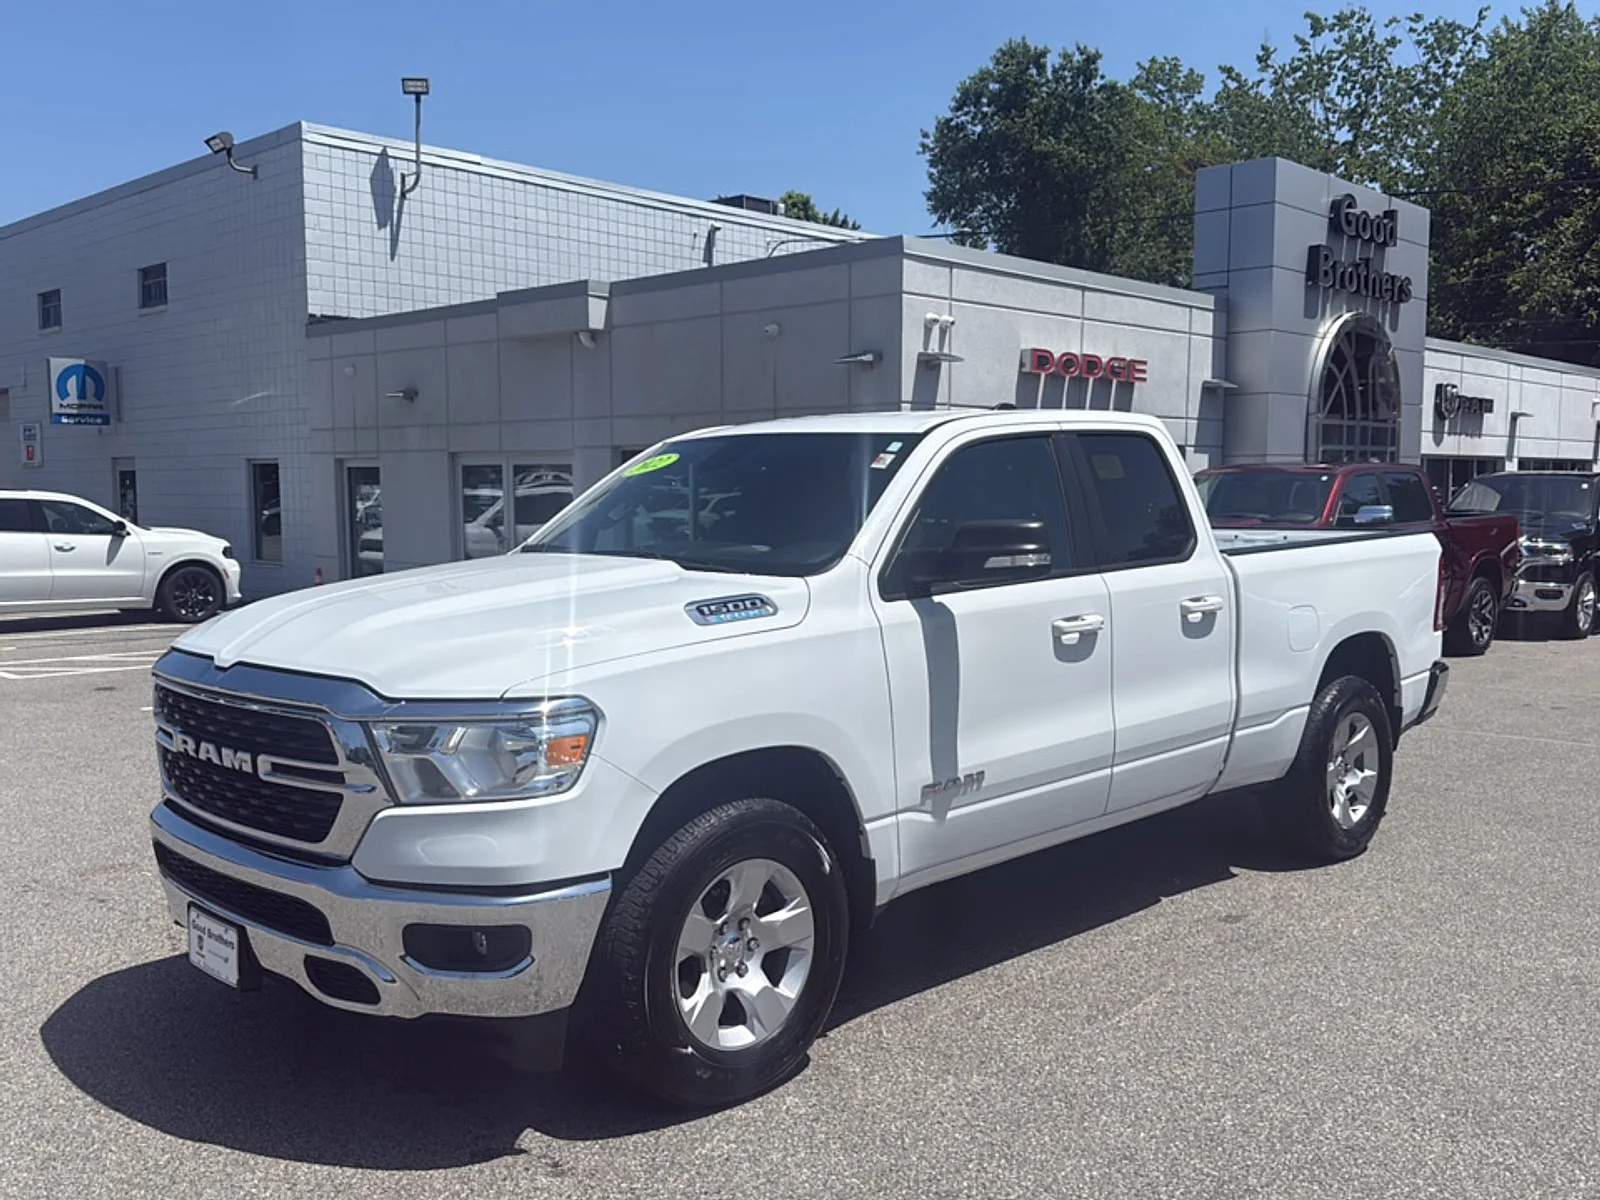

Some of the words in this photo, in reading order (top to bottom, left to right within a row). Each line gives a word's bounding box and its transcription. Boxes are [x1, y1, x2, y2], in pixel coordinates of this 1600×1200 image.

[1332, 193, 1398, 247] Good
[1307, 244, 1413, 304] Brothers
[1027, 348, 1147, 384] DODGE
[60, 415, 104, 424] Service
[700, 599, 761, 616] 1500
[176, 732, 253, 774] RAM
